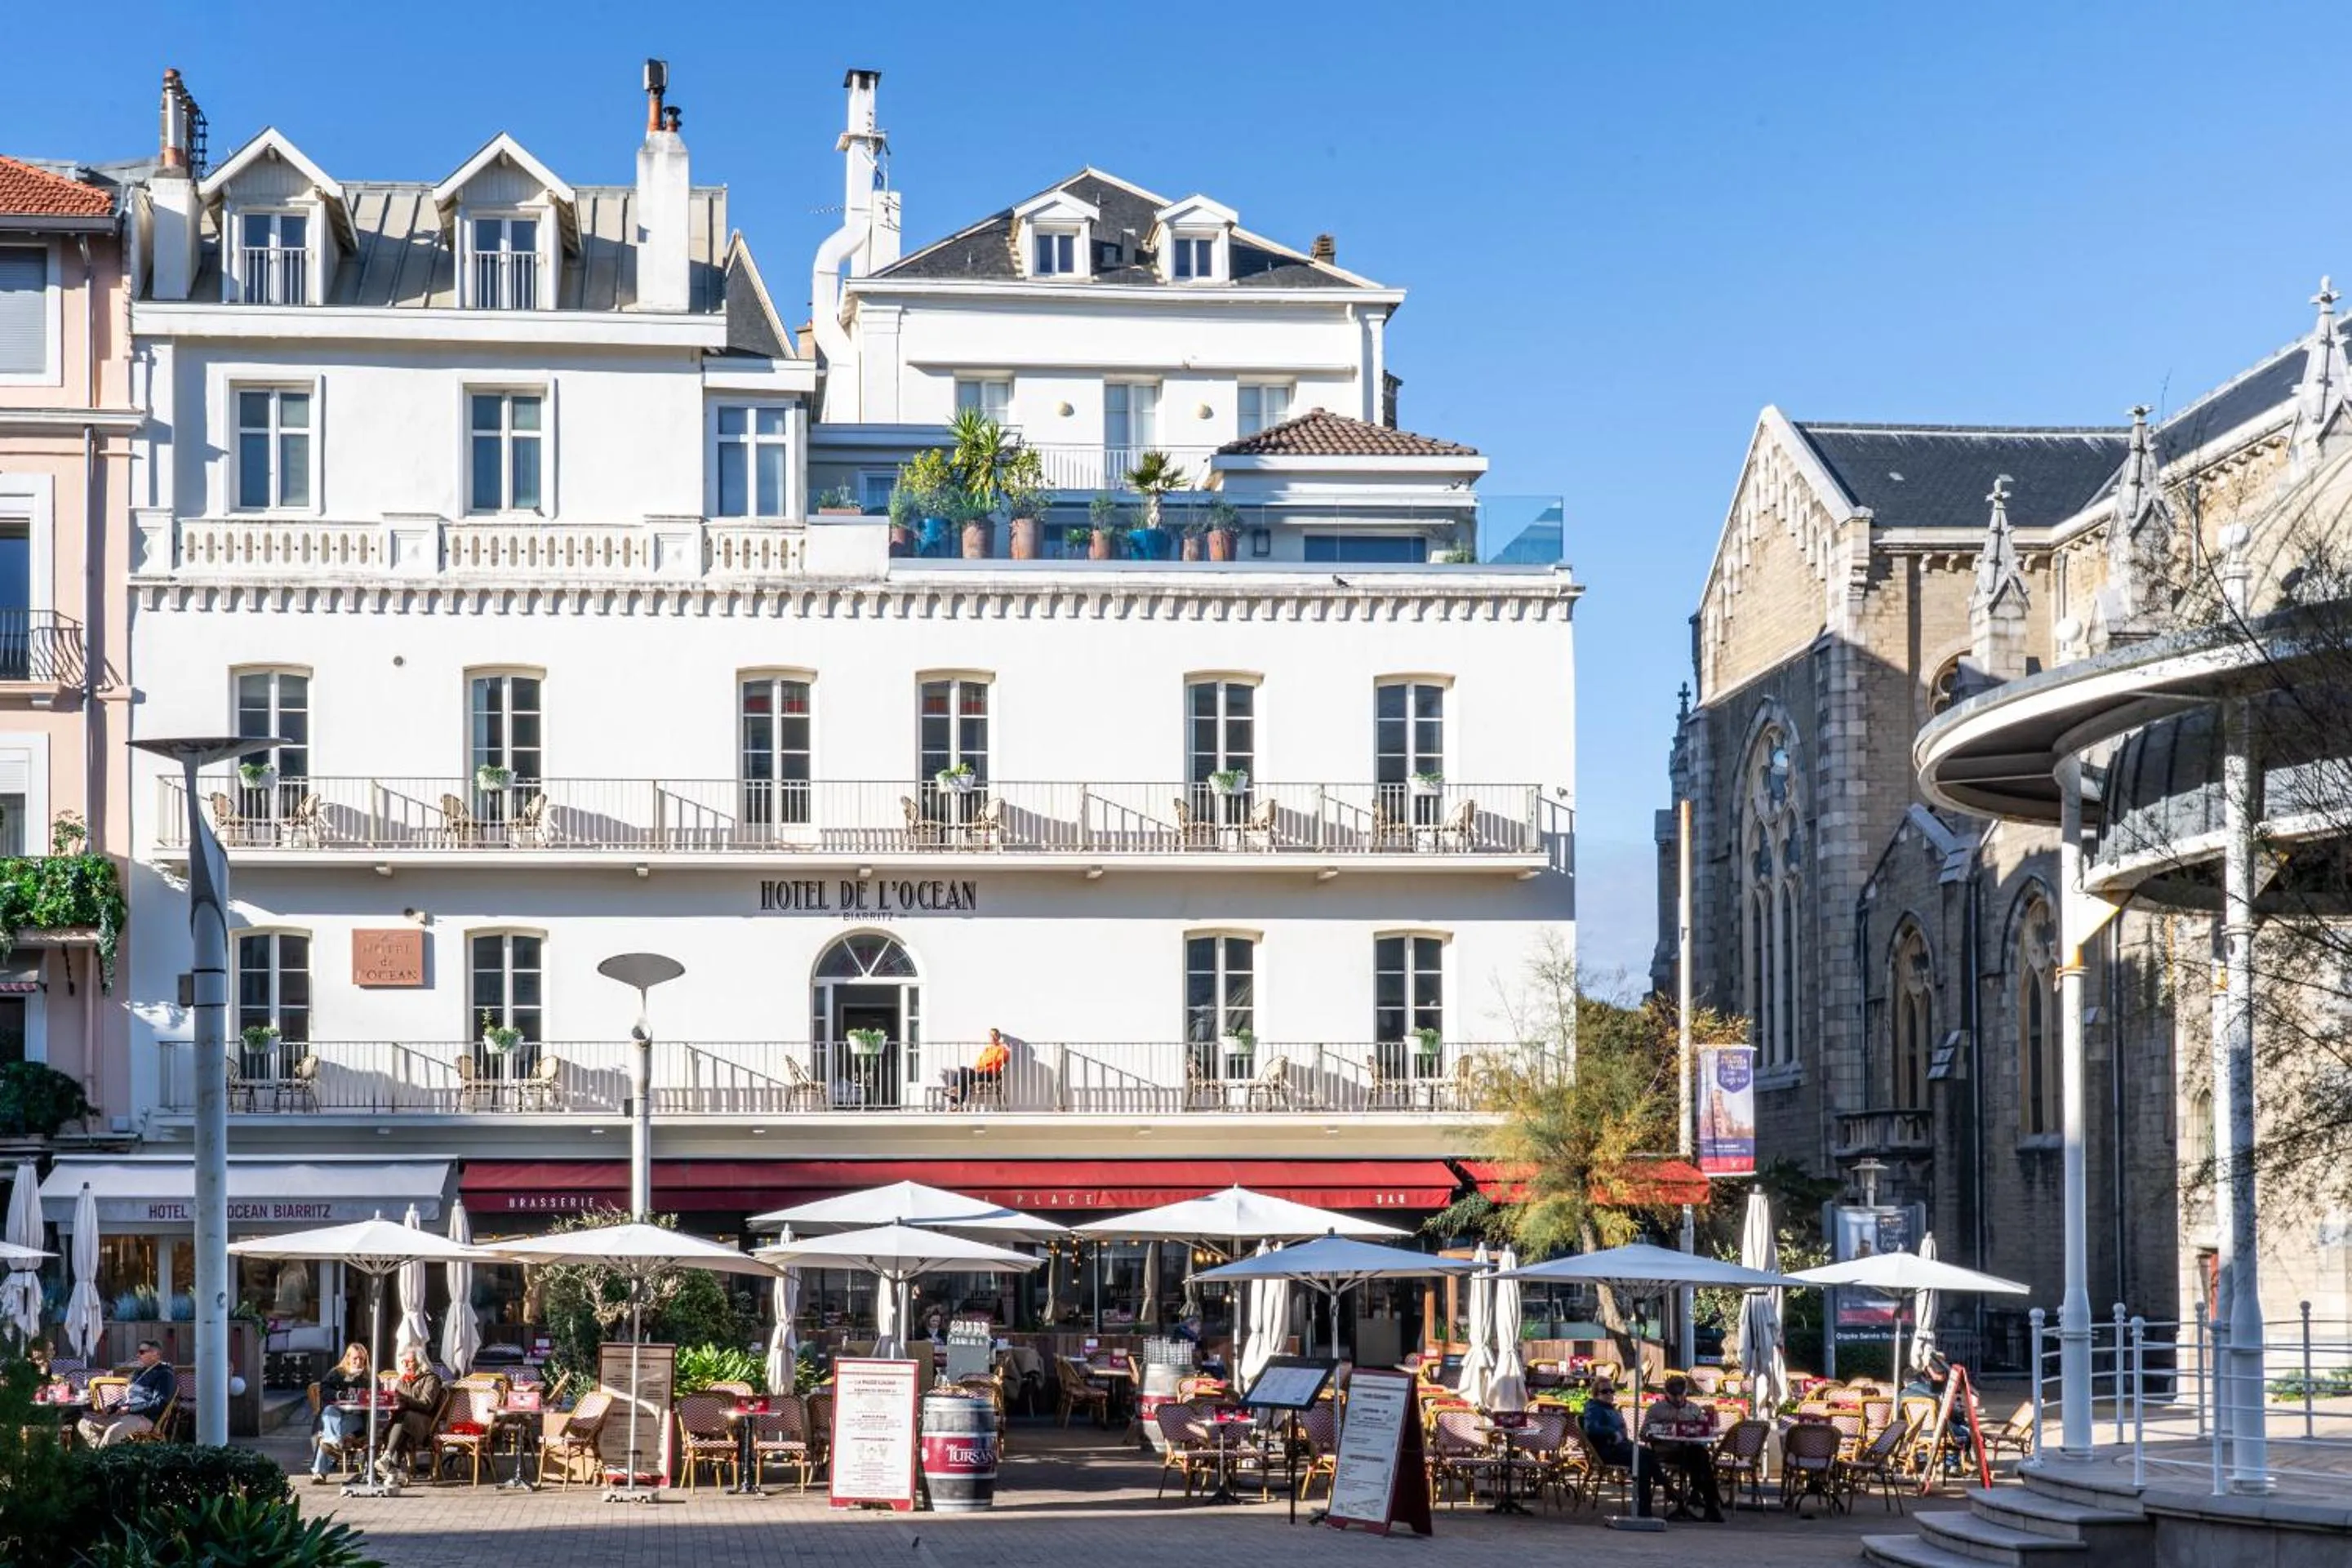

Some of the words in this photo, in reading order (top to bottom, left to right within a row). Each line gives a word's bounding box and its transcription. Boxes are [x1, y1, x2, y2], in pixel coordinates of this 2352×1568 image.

[760, 881, 830, 910] HOTEL
[839, 881, 869, 910] DE
[878, 880, 977, 910] L'OCEAN
[843, 913, 893, 922] BIARRITZ
[509, 1197, 594, 1208] BRASSERIE
[1016, 1194, 1092, 1205] PLACE
[1376, 1194, 1405, 1204] BAR
[148, 1204, 189, 1219] HOTEL
[273, 1204, 331, 1219] BIARRITZ
[945, 1444, 994, 1464] TURSAN
